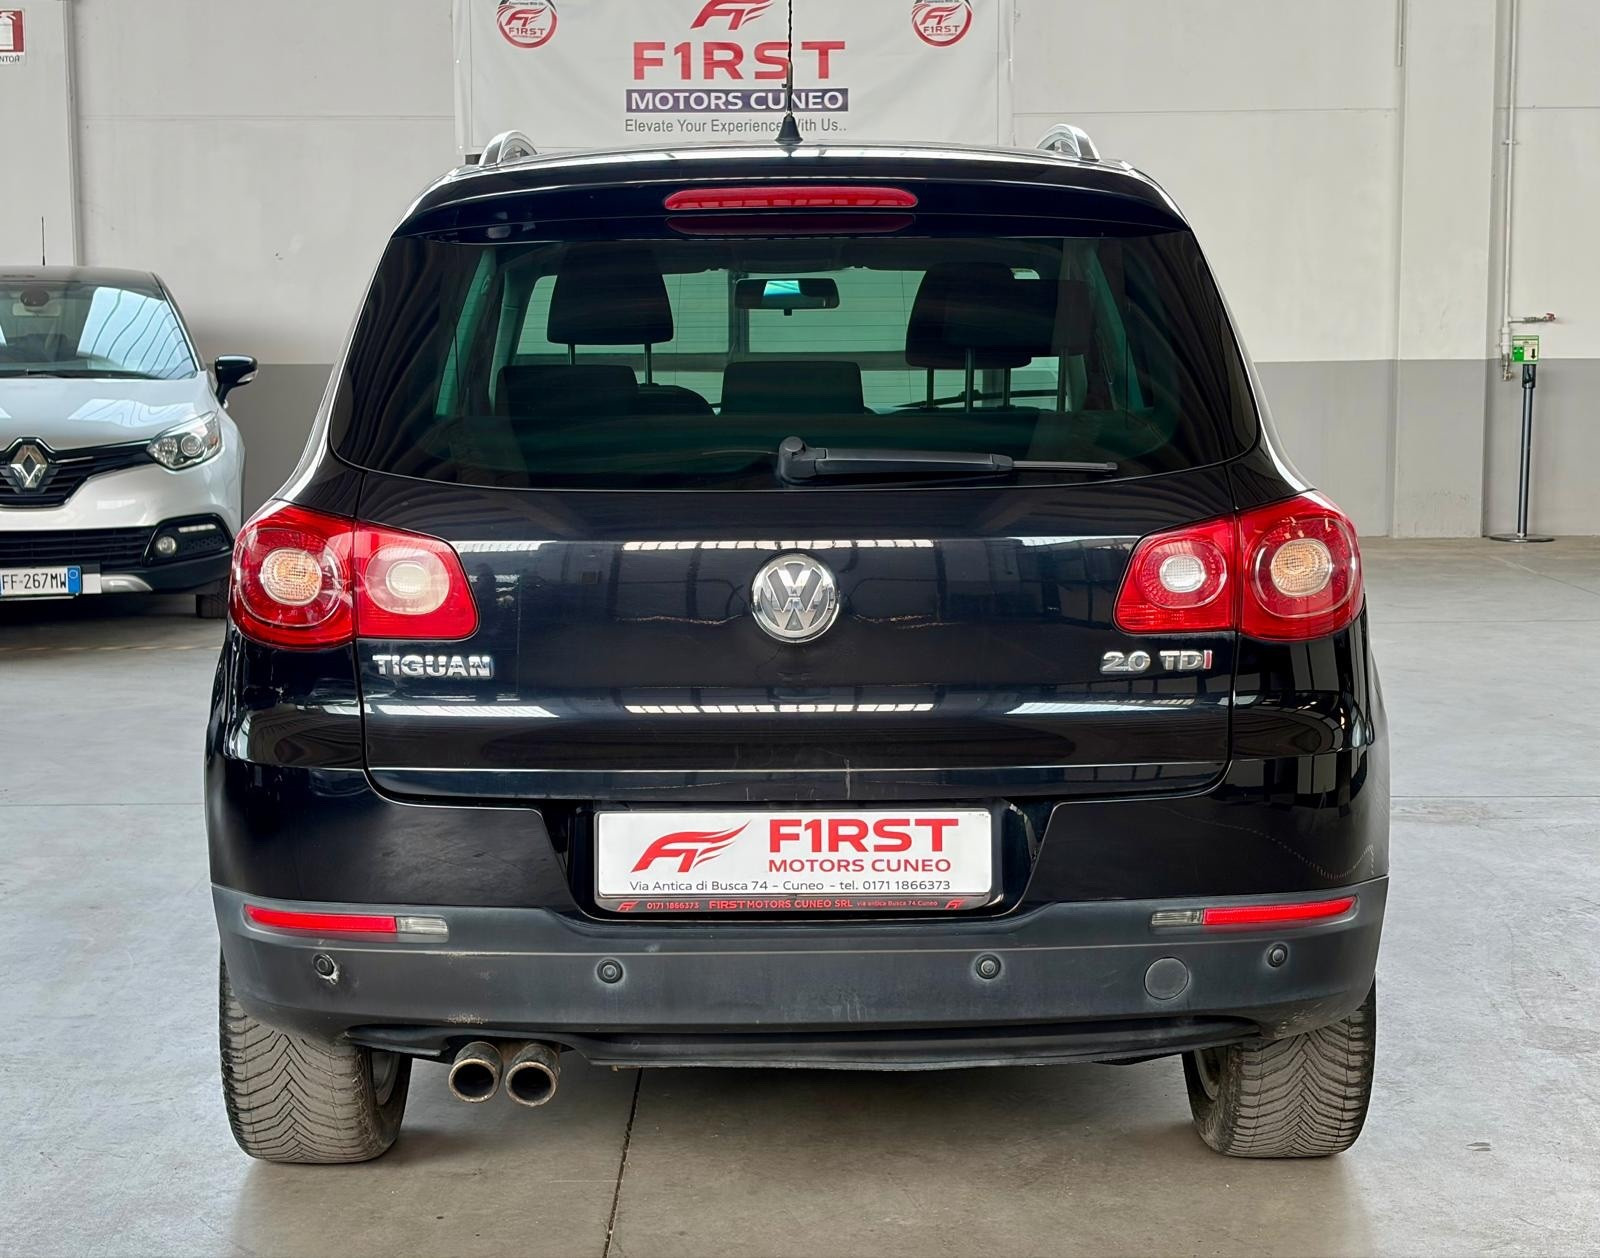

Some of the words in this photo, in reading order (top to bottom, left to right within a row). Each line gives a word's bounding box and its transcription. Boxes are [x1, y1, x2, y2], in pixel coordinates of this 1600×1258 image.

[633, 41, 846, 80] F1RST
[631, 91, 743, 110] MOTORS
[625, 119, 673, 132] Elevate
[677, 119, 708, 132] Your
[711, 120, 782, 135] Experience
[372, 655, 491, 677] TIGUAN
[1160, 650, 1212, 670] TDI
[769, 818, 959, 853] F1RST
[768, 859, 865, 873] MOTORS
[871, 859, 951, 873] CUNEO
[630, 881, 649, 891] Via
[653, 881, 693, 891] Antica
[696, 880, 708, 891] di
[711, 881, 748, 891] Busca
[752, 881, 768, 891] 74
[783, 881, 824, 890] Cuneo
[839, 881, 859, 890] tel.
[862, 881, 890, 890] 0171
[895, 881, 950, 890] 1866373
[747, 900, 791, 909] MOTORS
[794, 899, 831, 908] CUNEO
[834, 899, 853, 908] SRL
